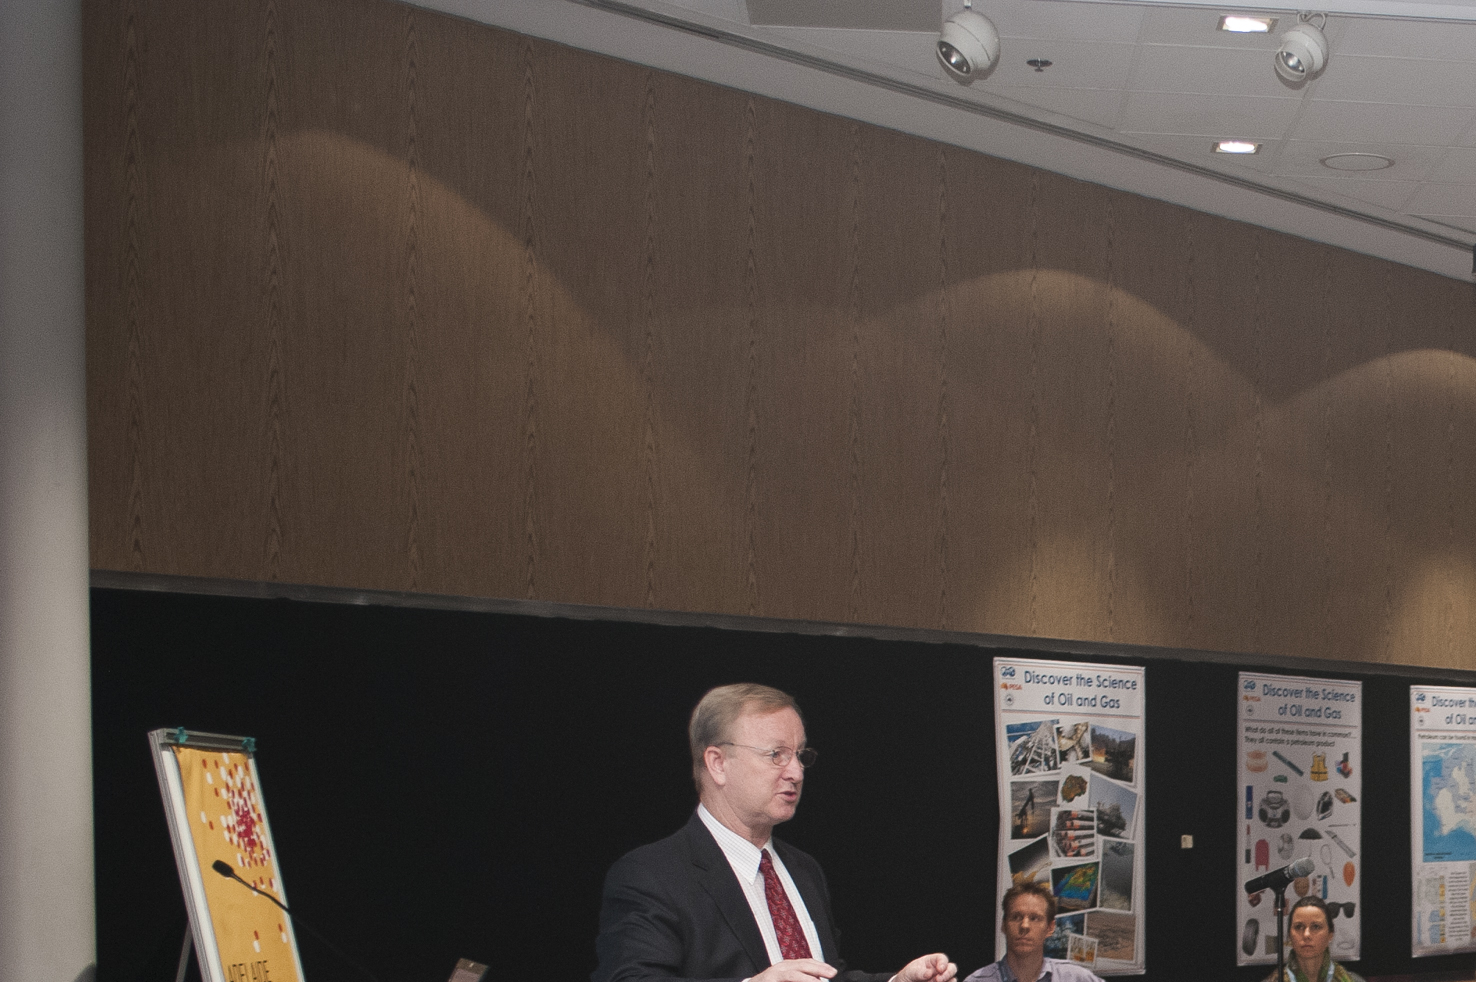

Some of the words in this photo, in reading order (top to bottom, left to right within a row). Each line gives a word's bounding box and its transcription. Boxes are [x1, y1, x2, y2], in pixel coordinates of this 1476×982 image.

[1024, 670, 1073, 686] Discover
[1076, 673, 1093, 688] the
[1096, 675, 1137, 691] Science
[1044, 692, 1054, 706] of
[1058, 692, 1073, 706] Oil
[1076, 694, 1097, 708] and
[1100, 696, 1120, 709] Gas
[1262, 684, 1304, 698] Discover
[1305, 686, 1319, 700] the
[1322, 688, 1356, 703] Science
[1432, 696, 1467, 708] Discover
[1278, 704, 1288, 716] of
[1290, 704, 1302, 717] Oil
[1304, 706, 1322, 718] and
[1324, 706, 1342, 720] Gas
[1445, 714, 1454, 725] of
[1456, 714, 1466, 725] Oil
